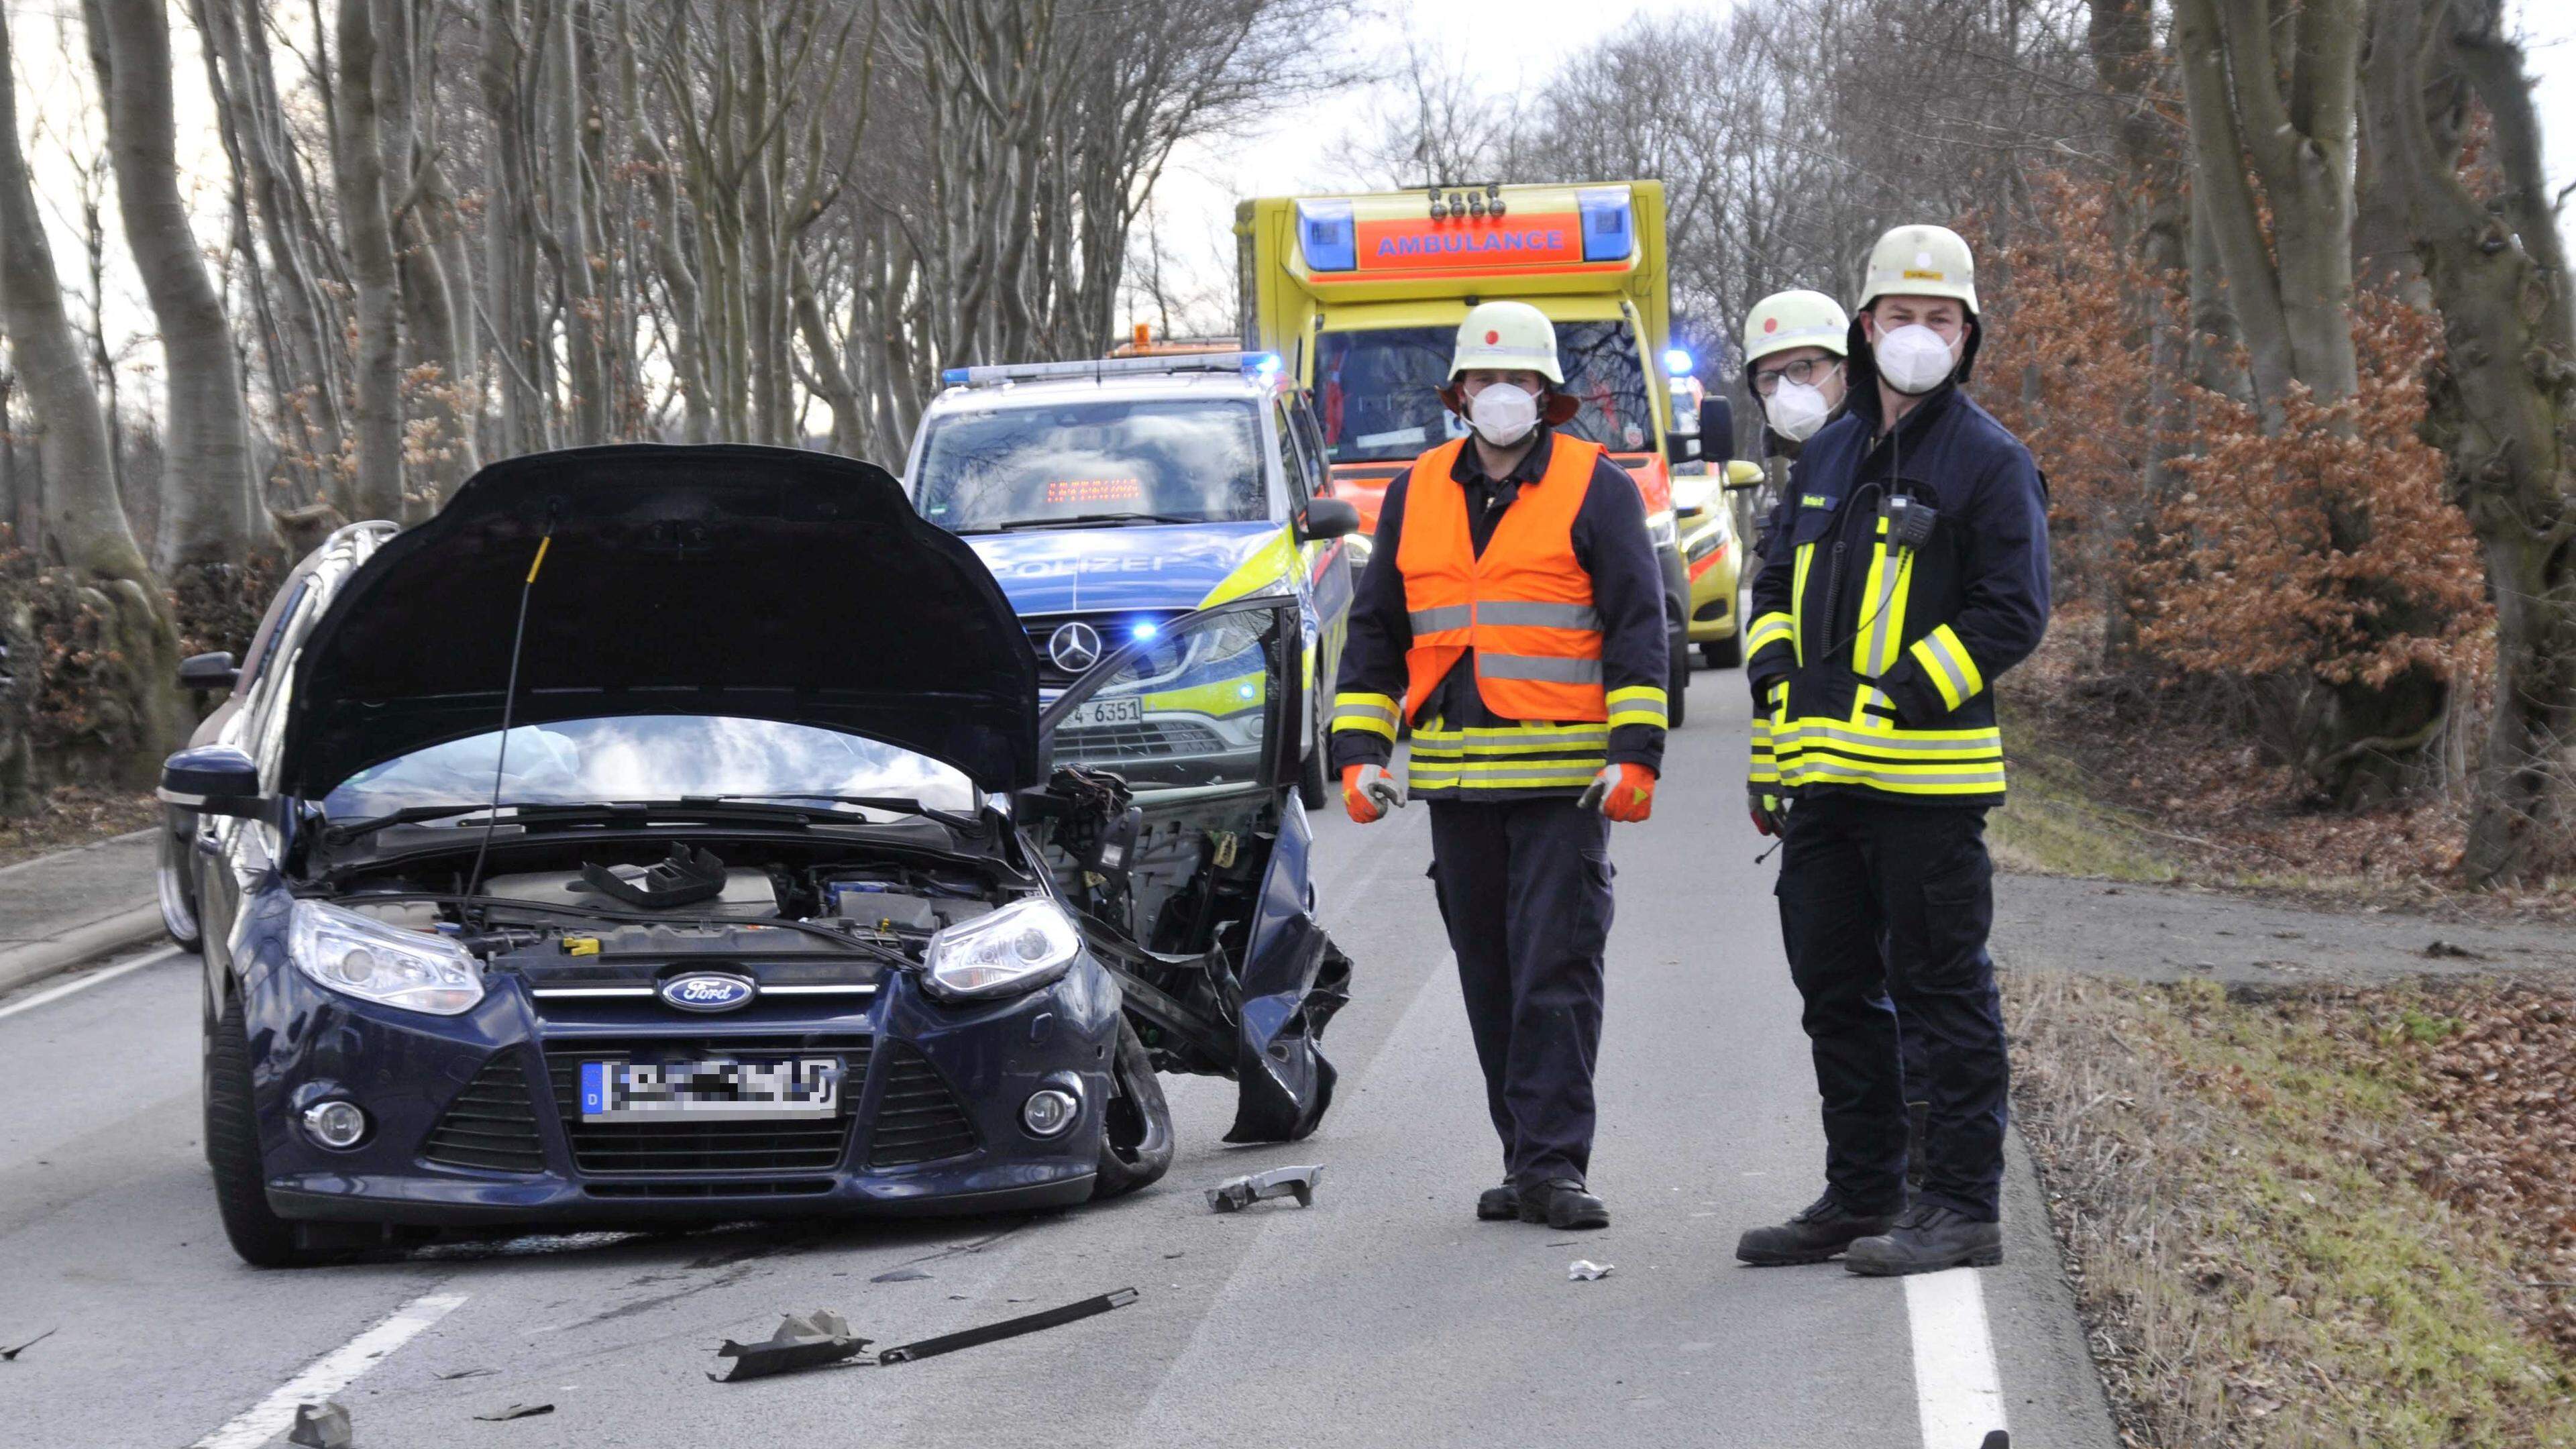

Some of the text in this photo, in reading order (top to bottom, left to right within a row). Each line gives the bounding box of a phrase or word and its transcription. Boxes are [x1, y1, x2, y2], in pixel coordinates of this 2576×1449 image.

[1378, 229, 1563, 256] AMBULANCE
[683, 980, 732, 1000] Ford
[588, 1093, 598, 1106] D
